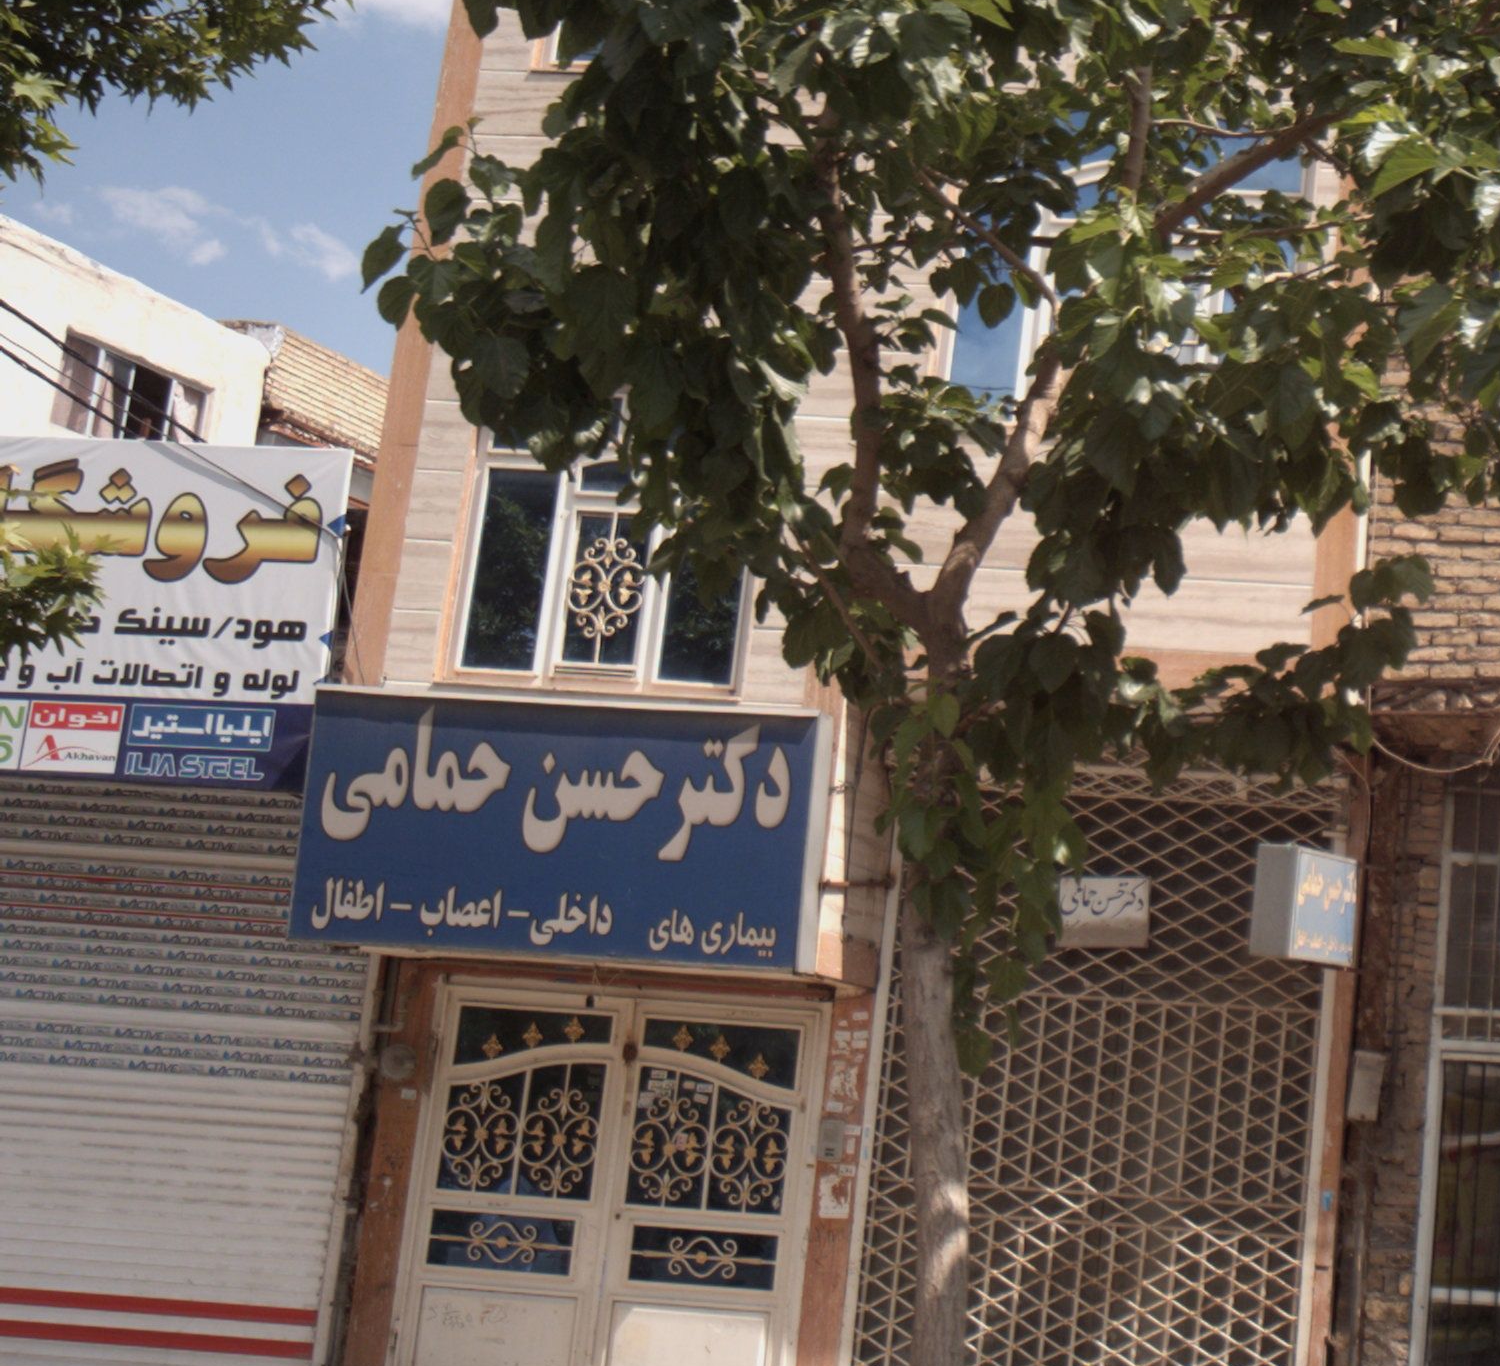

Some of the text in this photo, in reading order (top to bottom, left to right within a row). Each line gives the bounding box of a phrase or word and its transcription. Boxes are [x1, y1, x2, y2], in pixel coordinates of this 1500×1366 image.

[0, 458, 323, 584] فروشگا
[17, 664, 36, 689] و
[47, 658, 84, 691] آب
[93, 660, 203, 689] اتصالات
[213, 672, 231, 697] و
[243, 668, 300, 699] لوله
[33, 708, 118, 728] اخوان
[64, 752, 116, 763] Akhavan
[124, 752, 265, 780] ILIA STEEL
[319, 705, 791, 862] دکتر حسن حمامی
[265, 798, 299, 809] ACTIV
[258, 875, 291, 886] ACTIV
[1091, 889, 1125, 915] حسن
[1112, 879, 1147, 919] دکتر
[311, 876, 777, 957] بیماری های داخلی اعصاب اطفال
[0, 1036, 35, 1047] CTIVE
